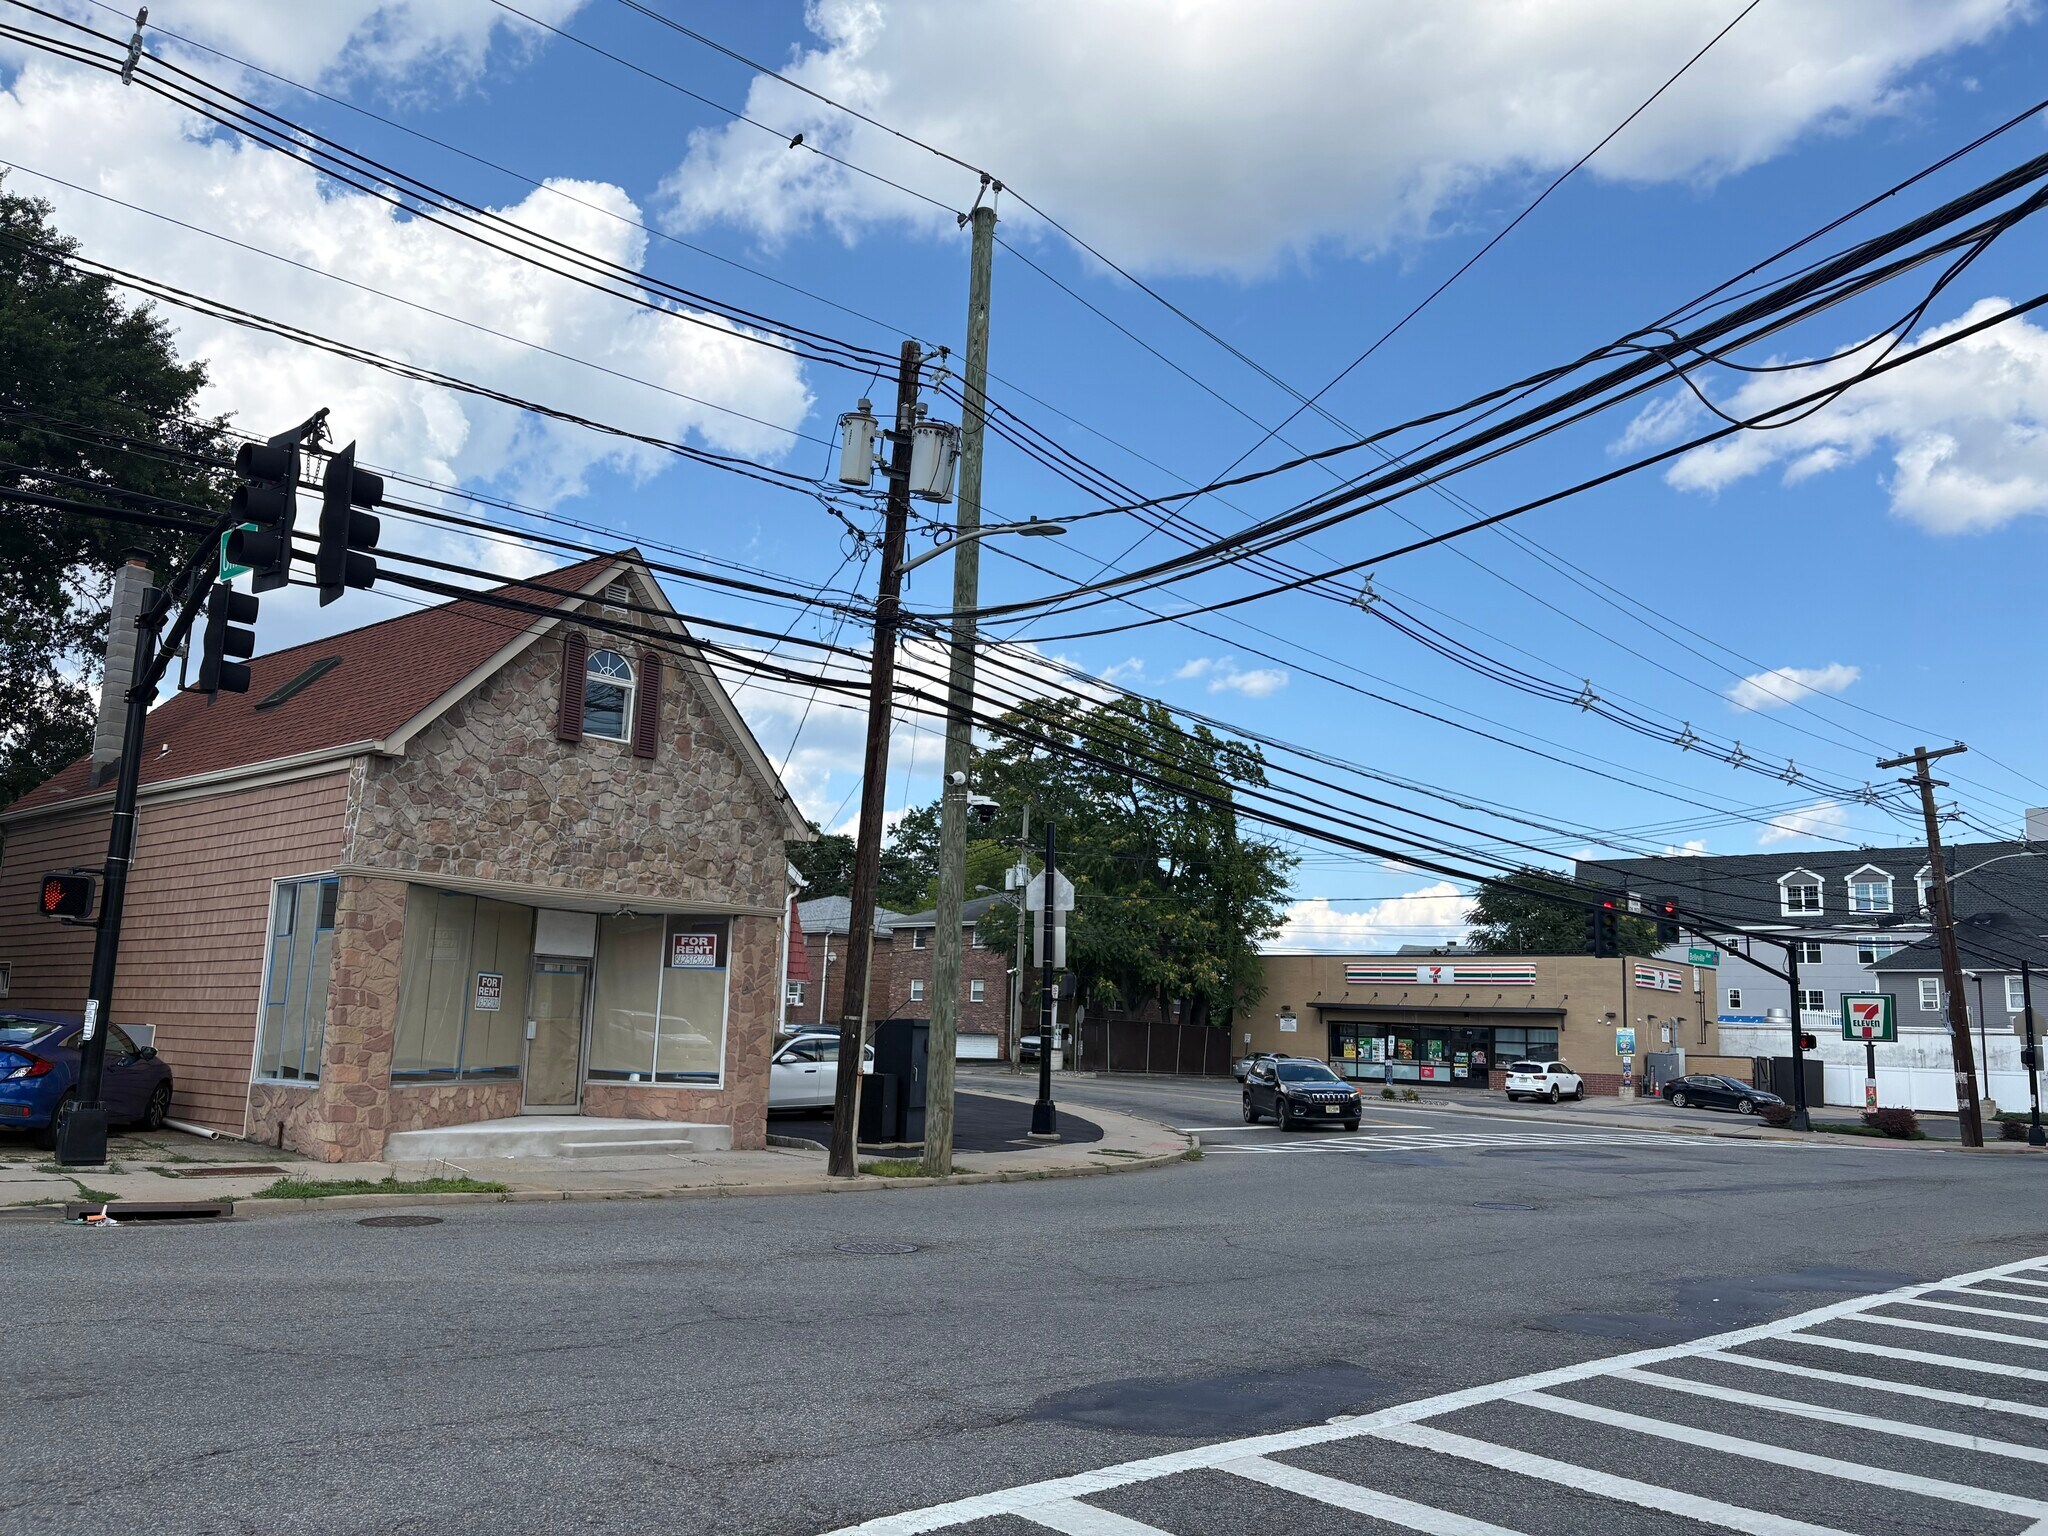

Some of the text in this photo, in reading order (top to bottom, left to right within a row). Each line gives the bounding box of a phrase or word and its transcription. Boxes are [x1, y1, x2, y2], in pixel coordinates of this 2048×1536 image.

[681, 937, 708, 945] FOR
[676, 946, 712, 954] RENT
[1430, 967, 1441, 983] 7
[482, 977, 498, 987] FOR
[478, 987, 499, 997] RENT
[1853, 1004, 1879, 1038] 7
